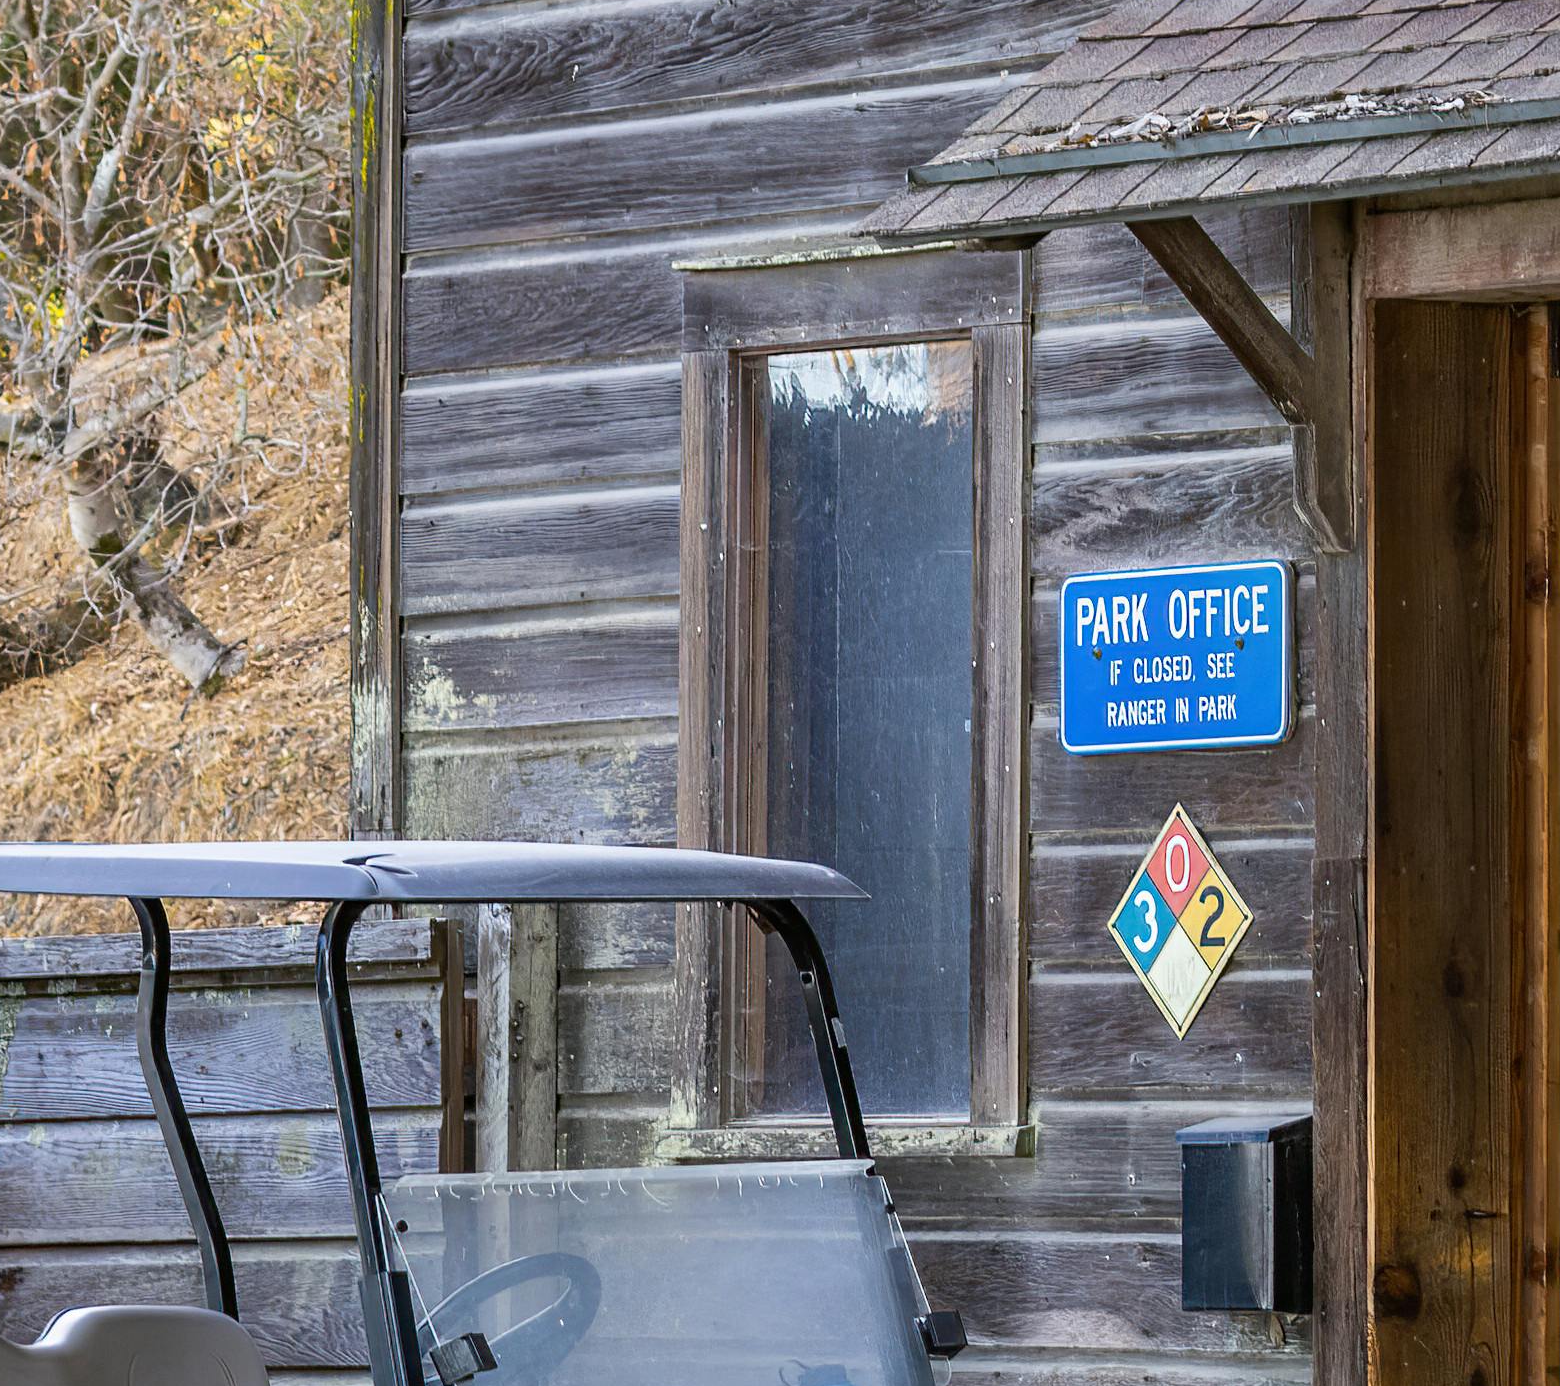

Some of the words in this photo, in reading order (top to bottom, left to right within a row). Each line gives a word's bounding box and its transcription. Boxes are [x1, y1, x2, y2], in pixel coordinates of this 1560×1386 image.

[1076, 593, 1149, 646] PARK
[1168, 585, 1269, 639] OFFICE
[1110, 660, 1122, 685] IF
[1134, 655, 1195, 684] CLOSED,
[1207, 653, 1235, 679] SEE
[1107, 699, 1166, 727] RANGER
[1175, 697, 1189, 723] IN
[1199, 695, 1237, 722] PARK
[1165, 834, 1190, 893] 0
[1133, 890, 1158, 953] 3
[1199, 885, 1225, 947] 2
